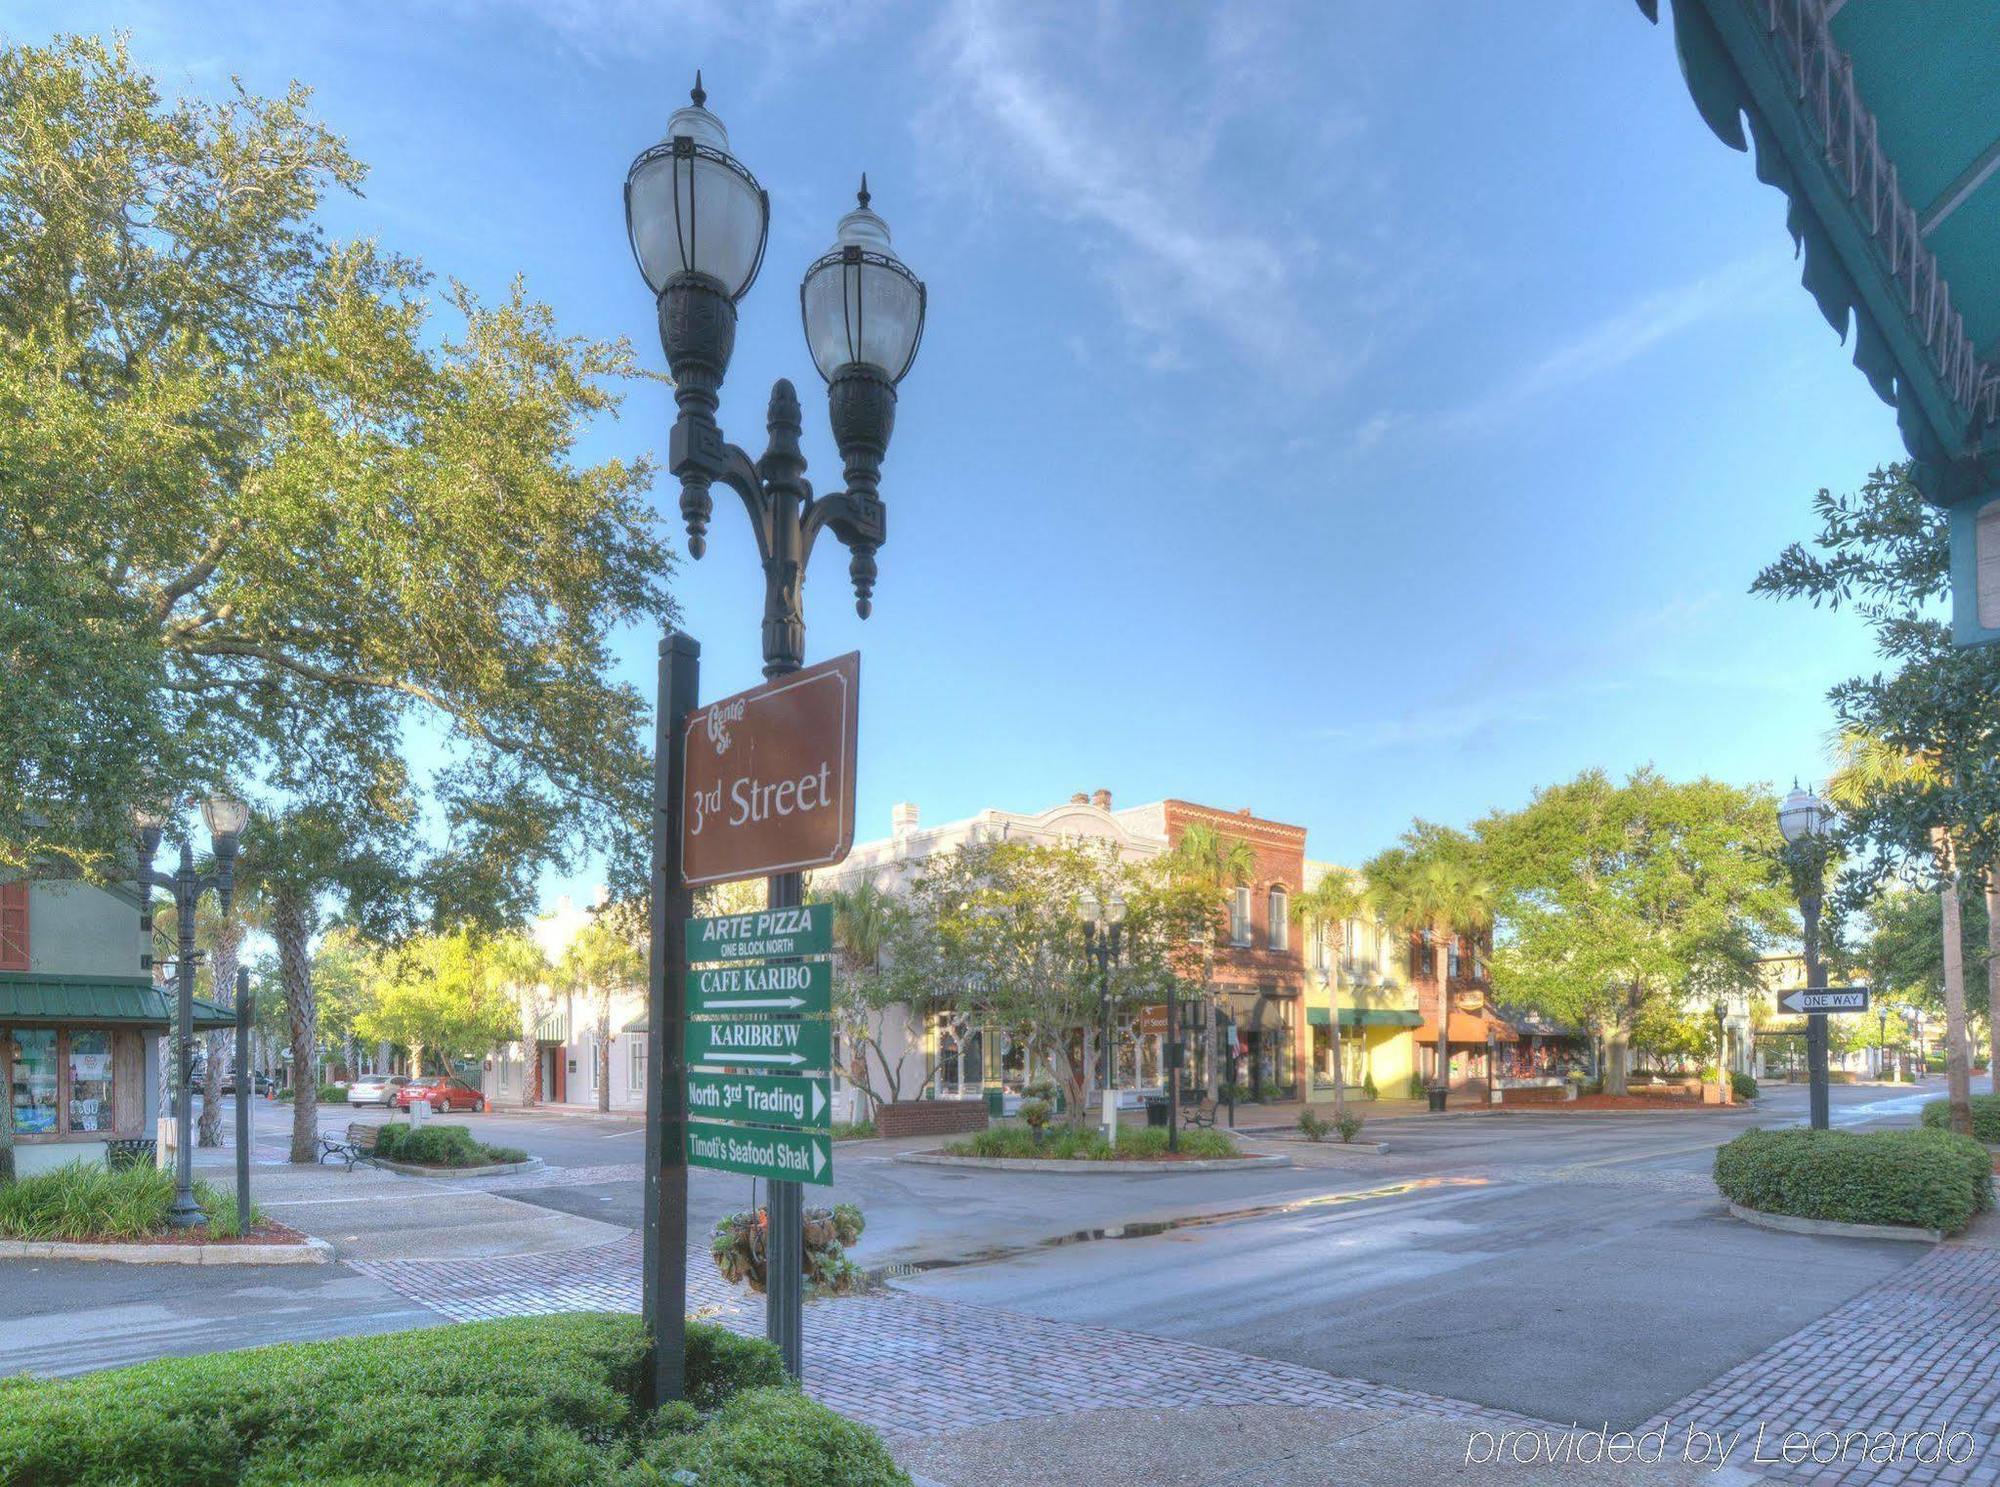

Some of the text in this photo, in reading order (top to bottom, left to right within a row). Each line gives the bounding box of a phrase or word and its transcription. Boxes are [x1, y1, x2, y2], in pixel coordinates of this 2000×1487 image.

[708, 699, 745, 742] Centre
[691, 761, 831, 836] 3rd Street
[702, 909, 812, 942] ARTE PIZZA
[721, 938, 794, 957] ONE BLOCK NORTH
[700, 966, 811, 993] CAFE KARIBO
[1804, 995, 1858, 1006] ONE WAY
[710, 1024, 801, 1047] KARIBREW
[688, 1082, 804, 1120] North 3rd Trading
[689, 1133, 810, 1171] Timoti's Seafood Shak
